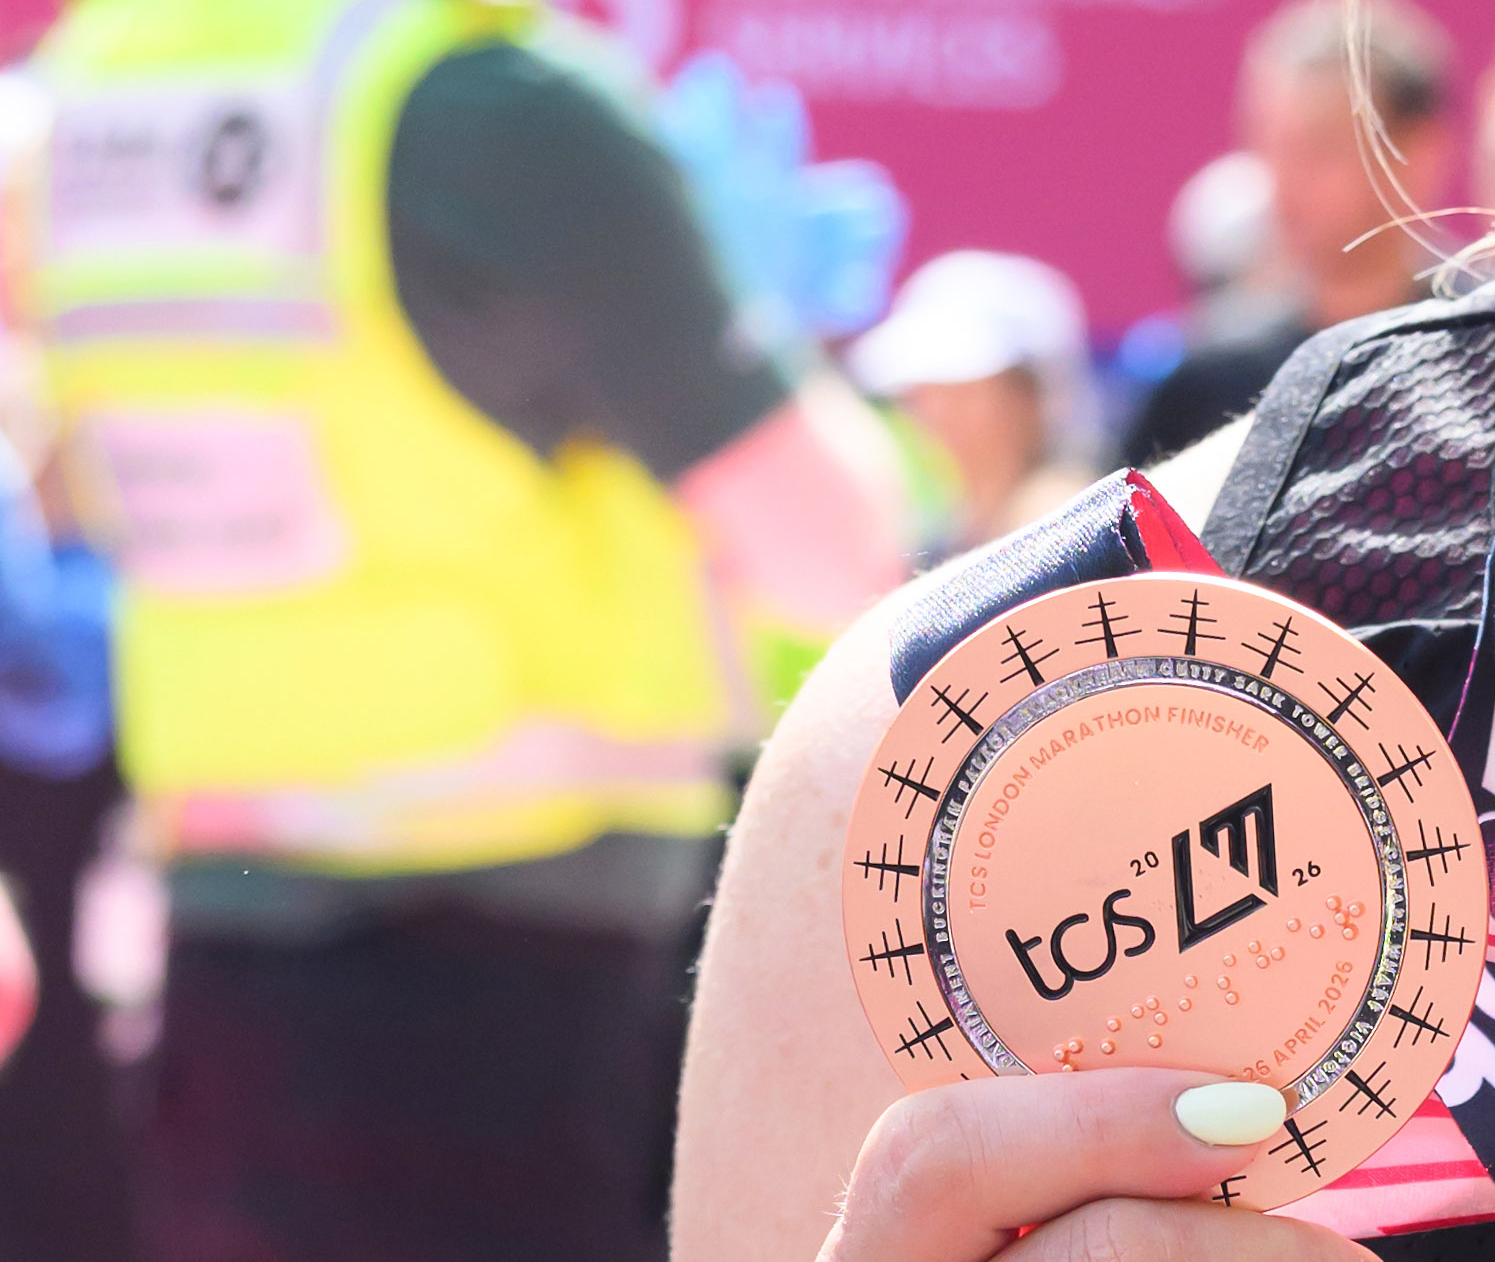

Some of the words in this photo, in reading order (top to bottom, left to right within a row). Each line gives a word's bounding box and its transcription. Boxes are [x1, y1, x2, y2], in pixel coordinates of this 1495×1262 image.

[1028, 706, 1162, 771] MARATHON
[1167, 705, 1270, 754] FINISHER
[1233, 675, 1287, 709] SARK
[1290, 704, 1349, 760] TOWER
[1346, 762, 1393, 837] BRIDGE
[973, 765, 1034, 861] LONDON
[967, 864, 988, 910] TCS
[1129, 850, 1160, 878] 20
[1291, 860, 1322, 887] 26
[1004, 888, 1157, 1002] tcs
[1243, 1059, 1271, 1081] 26
[1272, 1016, 1327, 1067] APRIL
[1317, 960, 1354, 1015] 2026
